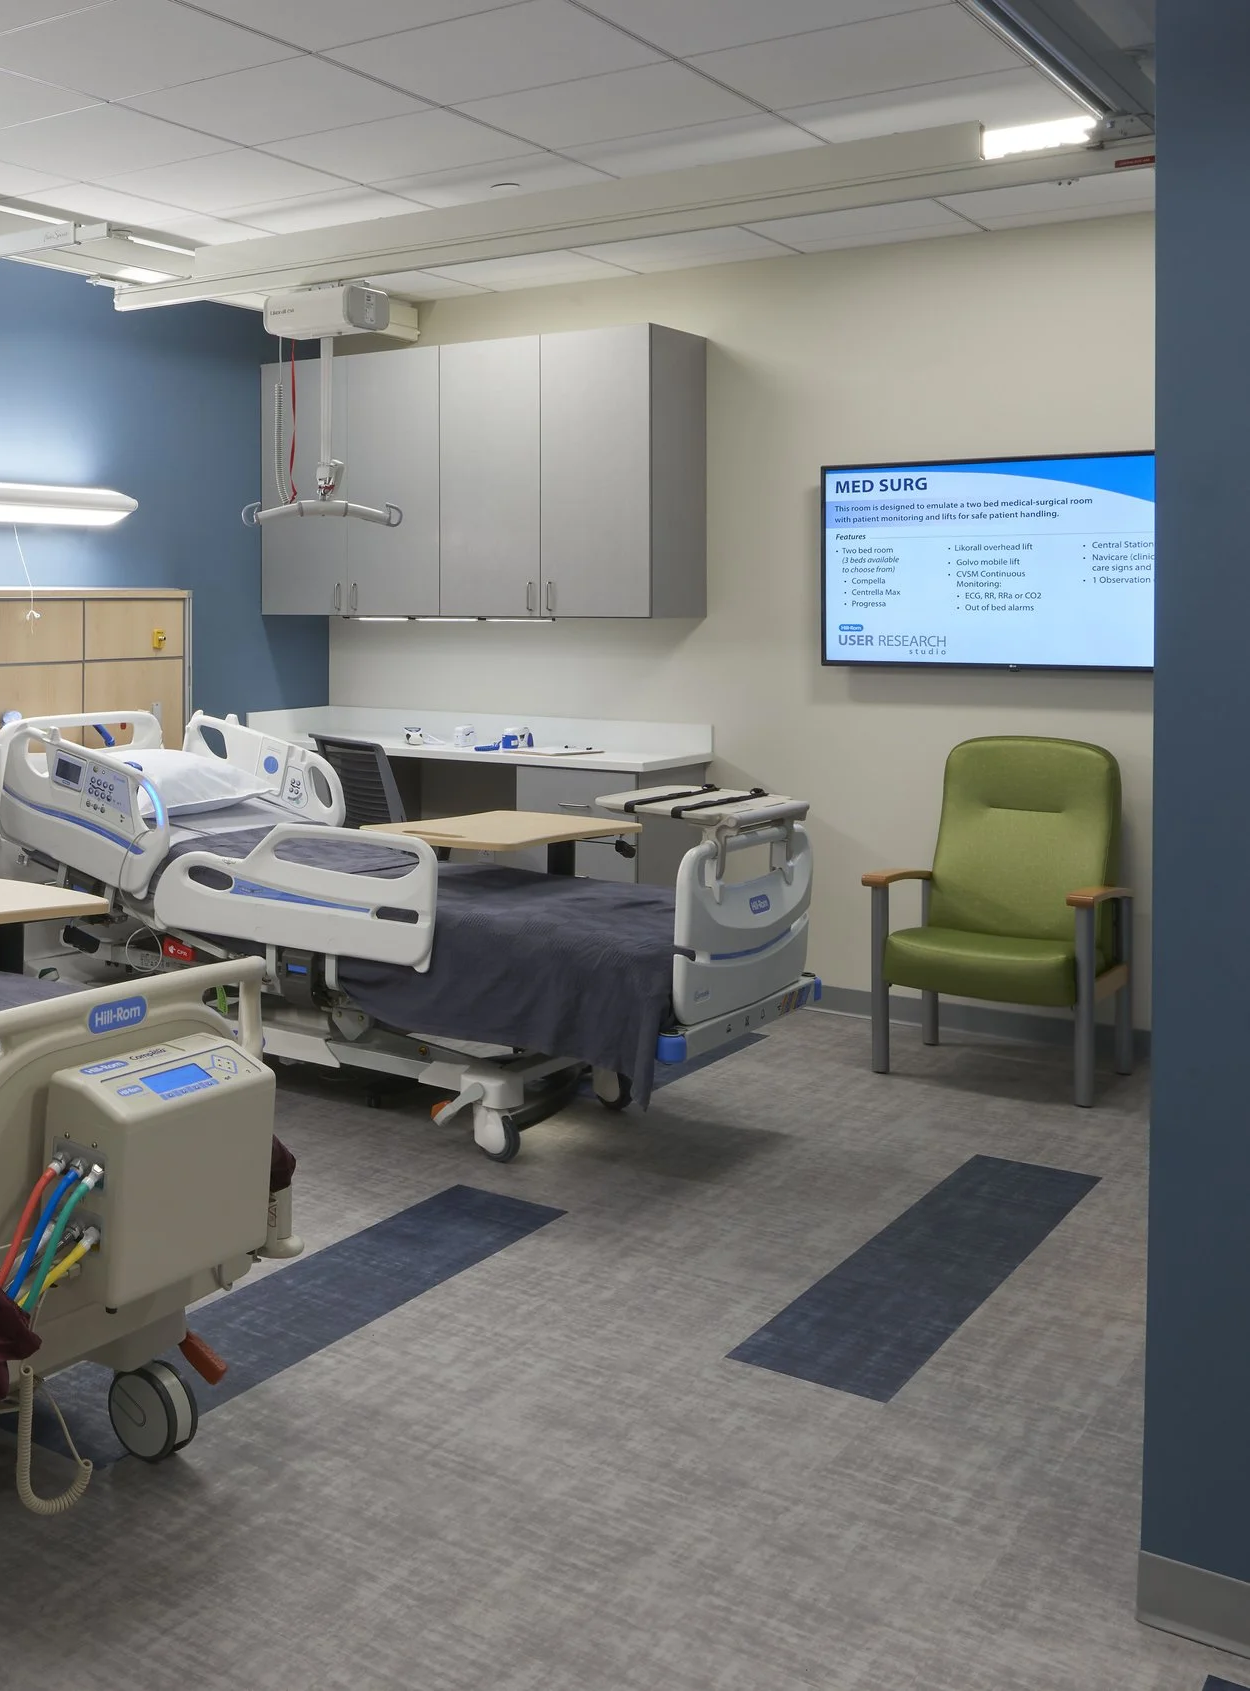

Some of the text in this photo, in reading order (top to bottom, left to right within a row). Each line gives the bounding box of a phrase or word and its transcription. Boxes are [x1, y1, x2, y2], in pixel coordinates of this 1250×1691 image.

[835, 477, 928, 494] MED SURG
[880, 503, 915, 513] designed
[983, 499, 999, 507] bed
[1000, 498, 1068, 508] medical-surgical
[834, 510, 1060, 524] with patient monitoring and lifts for safe patient handling.
[954, 543, 982, 551] Likorall
[983, 543, 1021, 551] overhead
[849, 556, 867, 564] beds
[1092, 553, 1129, 561] Navicare
[956, 558, 979, 566] Golvo
[875, 565, 896, 573] from)
[1111, 564, 1133, 573] signs
[955, 569, 1026, 578] CVSM Continuous
[851, 577, 886, 585] Compella
[1099, 576, 1151, 584] Observation
[956, 580, 1002, 589] Monitoring:
[851, 588, 901, 596] Centrella Max
[998, 592, 1013, 600] RRa
[1024, 592, 1042, 600] CO2
[851, 600, 887, 608] Progressa
[838, 634, 947, 647] USER RESEARCH
[94, 1005, 141, 1028] Hill-Rom
